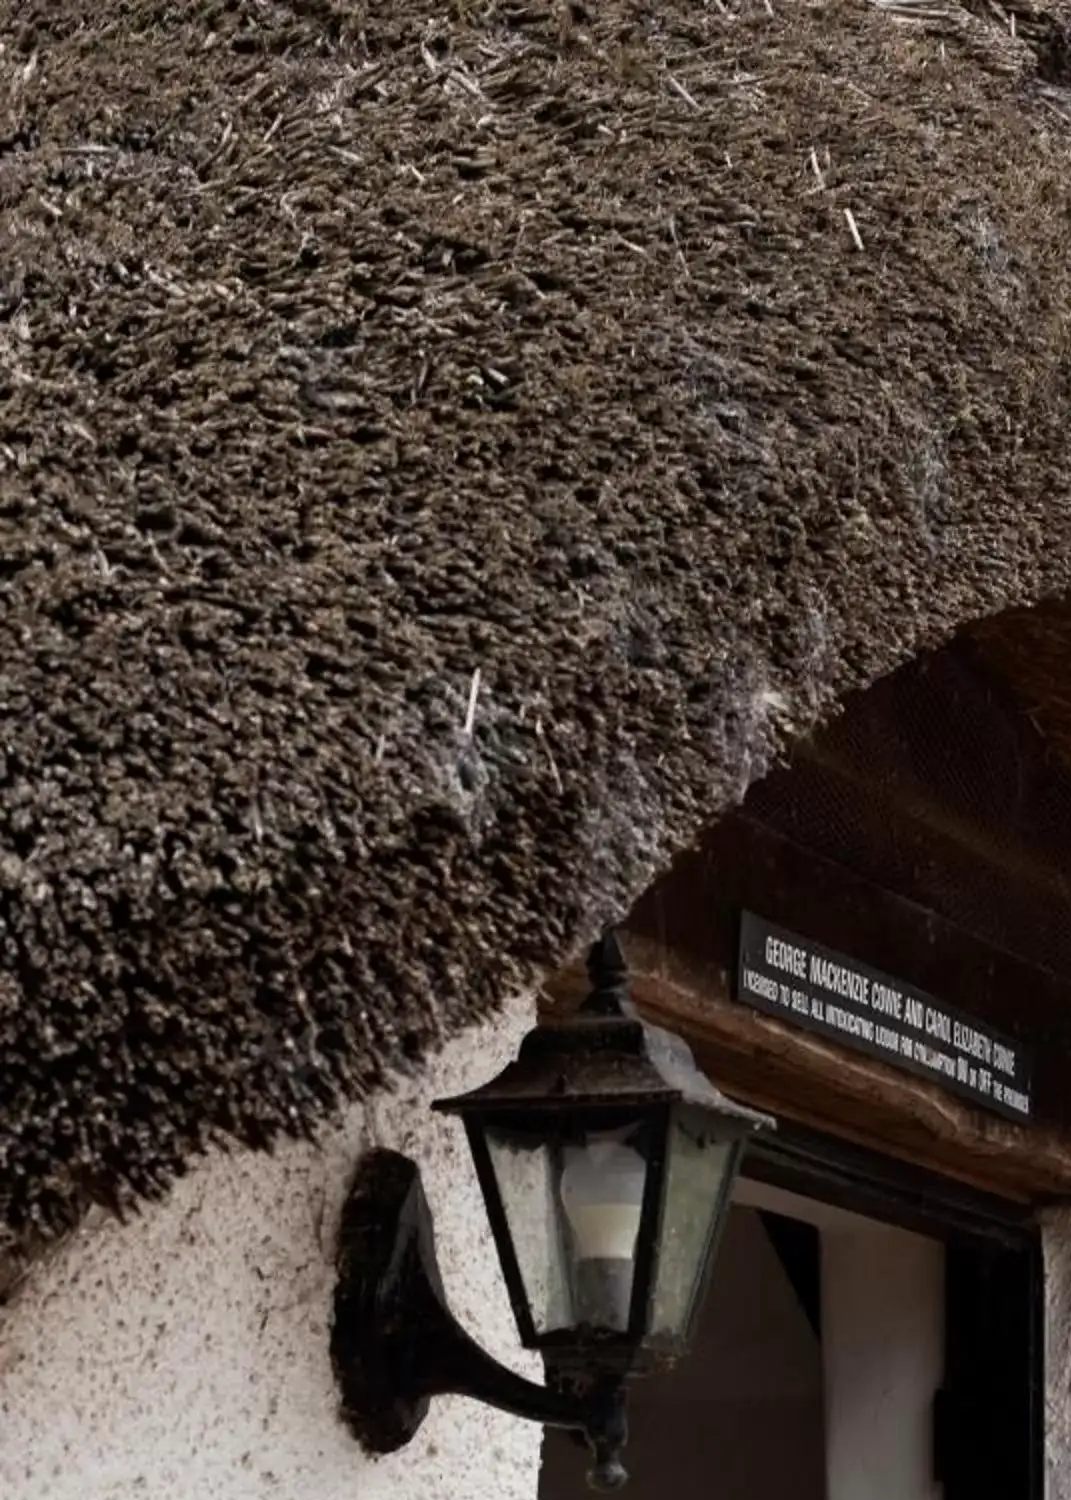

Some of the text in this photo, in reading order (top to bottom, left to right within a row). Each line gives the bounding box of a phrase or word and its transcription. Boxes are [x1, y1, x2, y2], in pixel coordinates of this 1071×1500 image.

[766, 935, 807, 979] GEORGE
[809, 955, 868, 1005] MACKENZIE
[904, 997, 923, 1029] AND
[811, 998, 824, 1020] ALL
